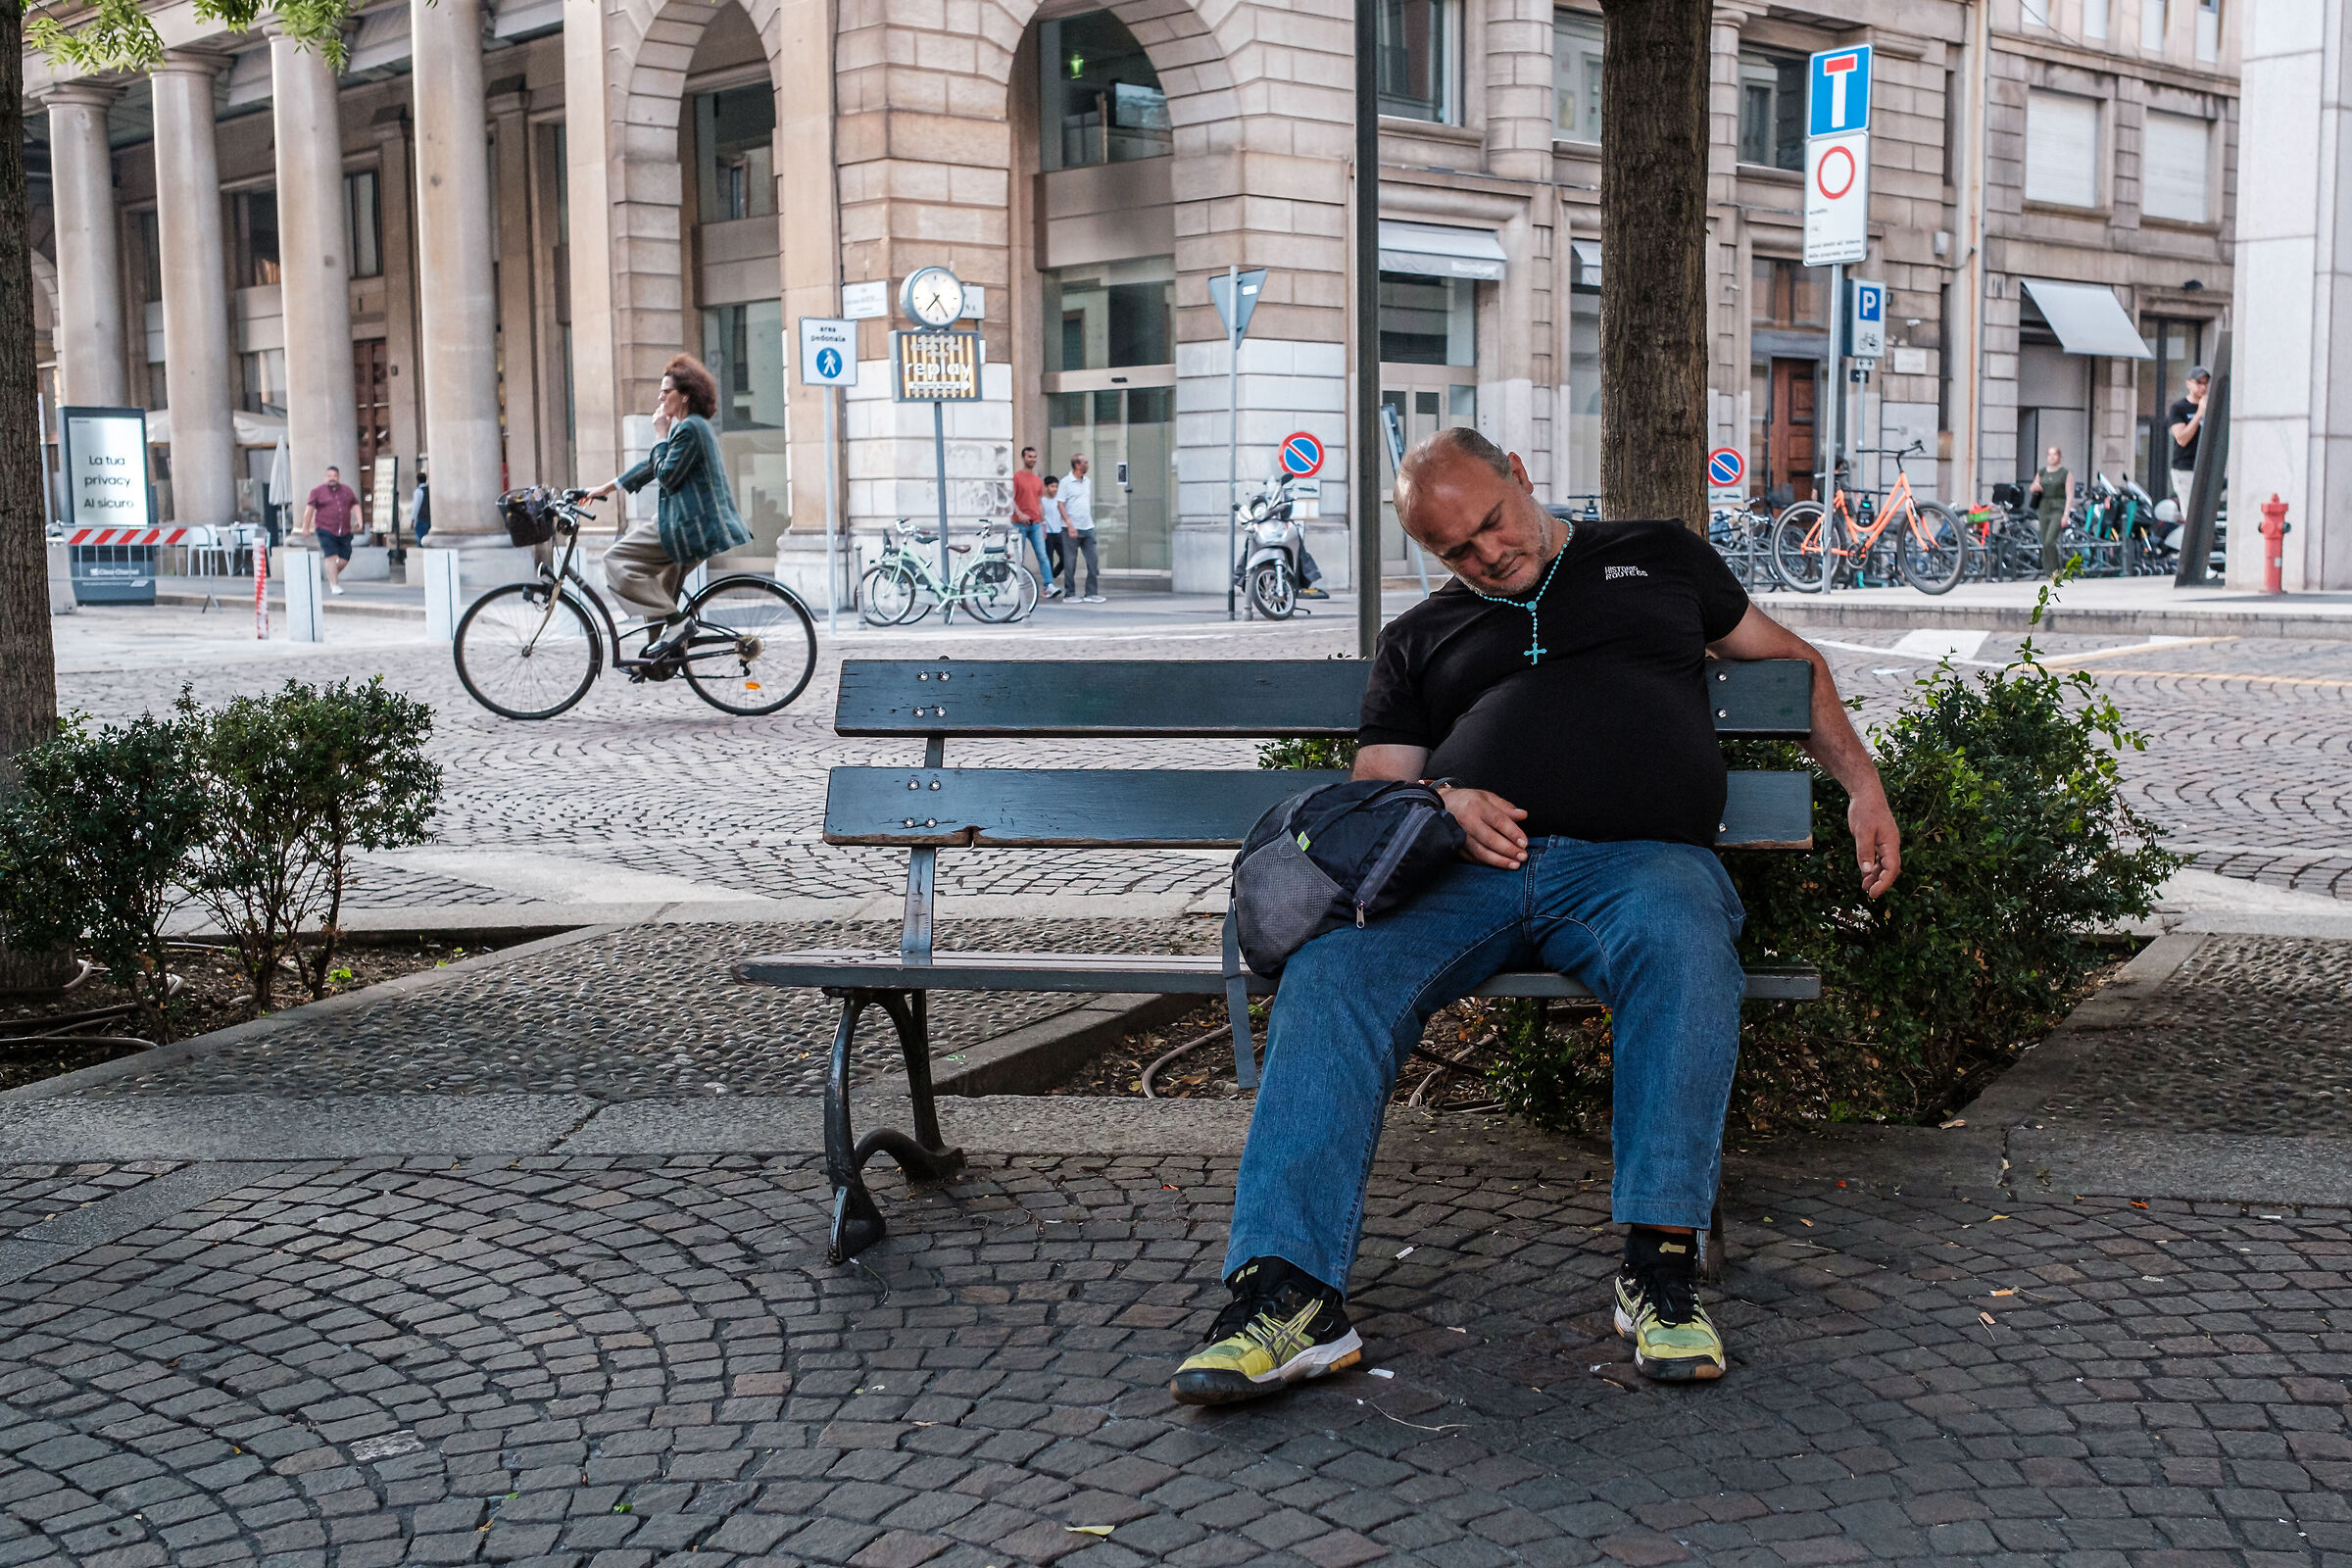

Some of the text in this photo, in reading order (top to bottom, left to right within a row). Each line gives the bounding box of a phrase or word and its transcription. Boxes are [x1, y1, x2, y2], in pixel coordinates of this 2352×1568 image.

[1863, 290, 1877, 317] P
[905, 359, 972, 380] replay
[88, 455, 125, 466] La tua
[84, 475, 130, 488] privacy
[97, 498, 134, 509] sicuro
[1605, 570, 1636, 580] ROUTE
